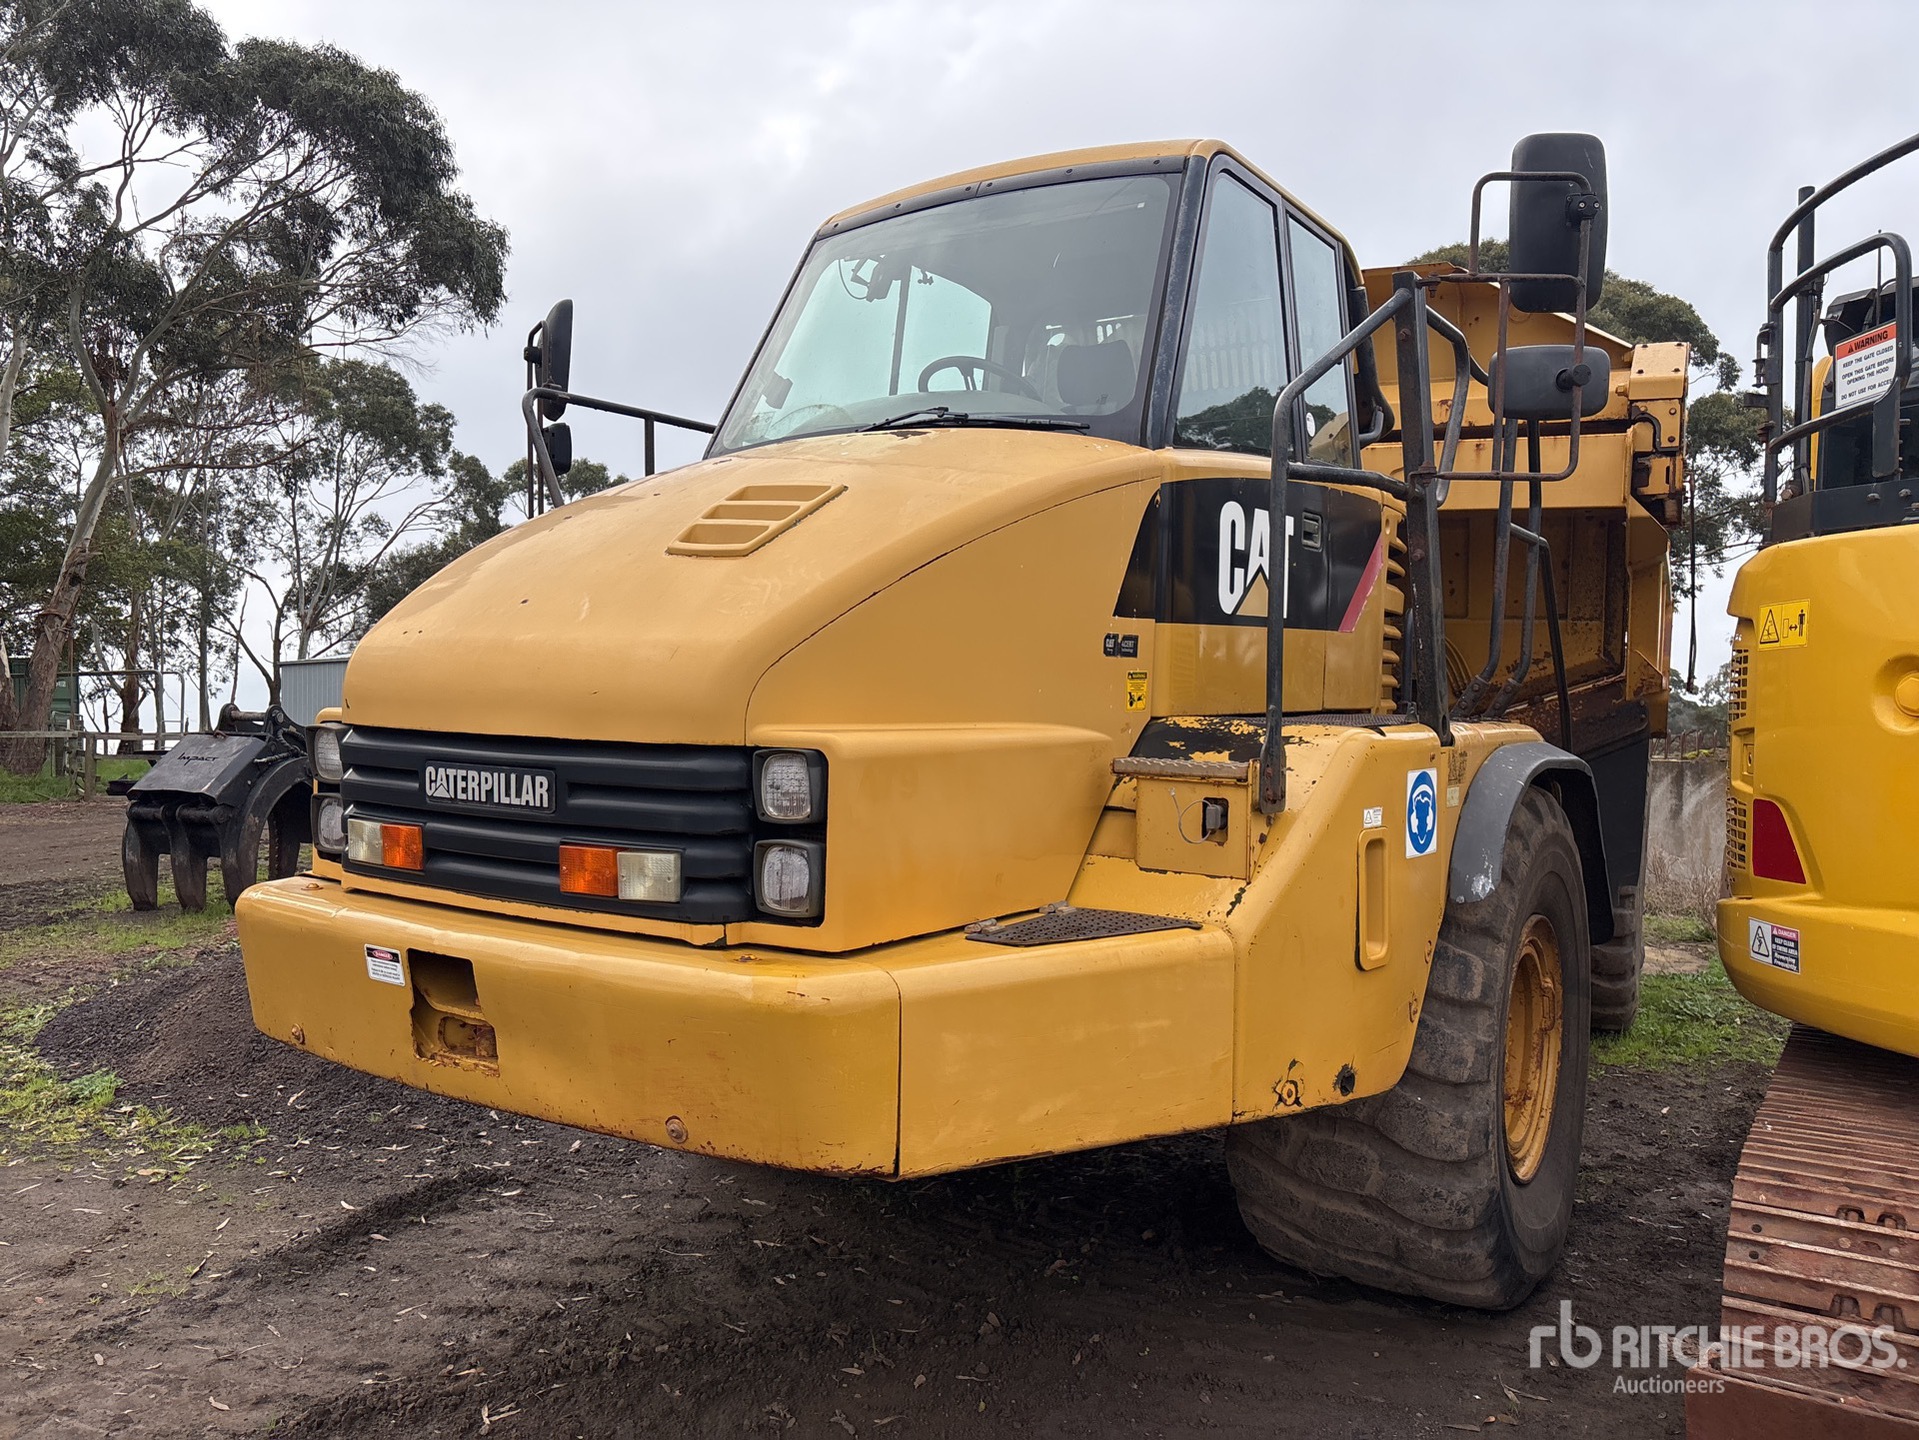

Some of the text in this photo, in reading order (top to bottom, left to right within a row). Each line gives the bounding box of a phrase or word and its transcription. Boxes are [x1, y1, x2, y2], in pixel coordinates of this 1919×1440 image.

[1854, 331, 1888, 350] WARNING
[1843, 360, 1853, 368] KEEP
[1864, 351, 1875, 361] GATE
[1876, 345, 1893, 356] CLOSED
[1842, 372, 1853, 380] OPEN
[1865, 363, 1876, 371] GATE
[1877, 357, 1894, 367] BEFORE
[1847, 374, 1865, 385] OPENING
[1876, 366, 1889, 374] HOOD
[426, 766, 549, 807] CATERPILLAR
[1778, 929, 1796, 938] DANGER
